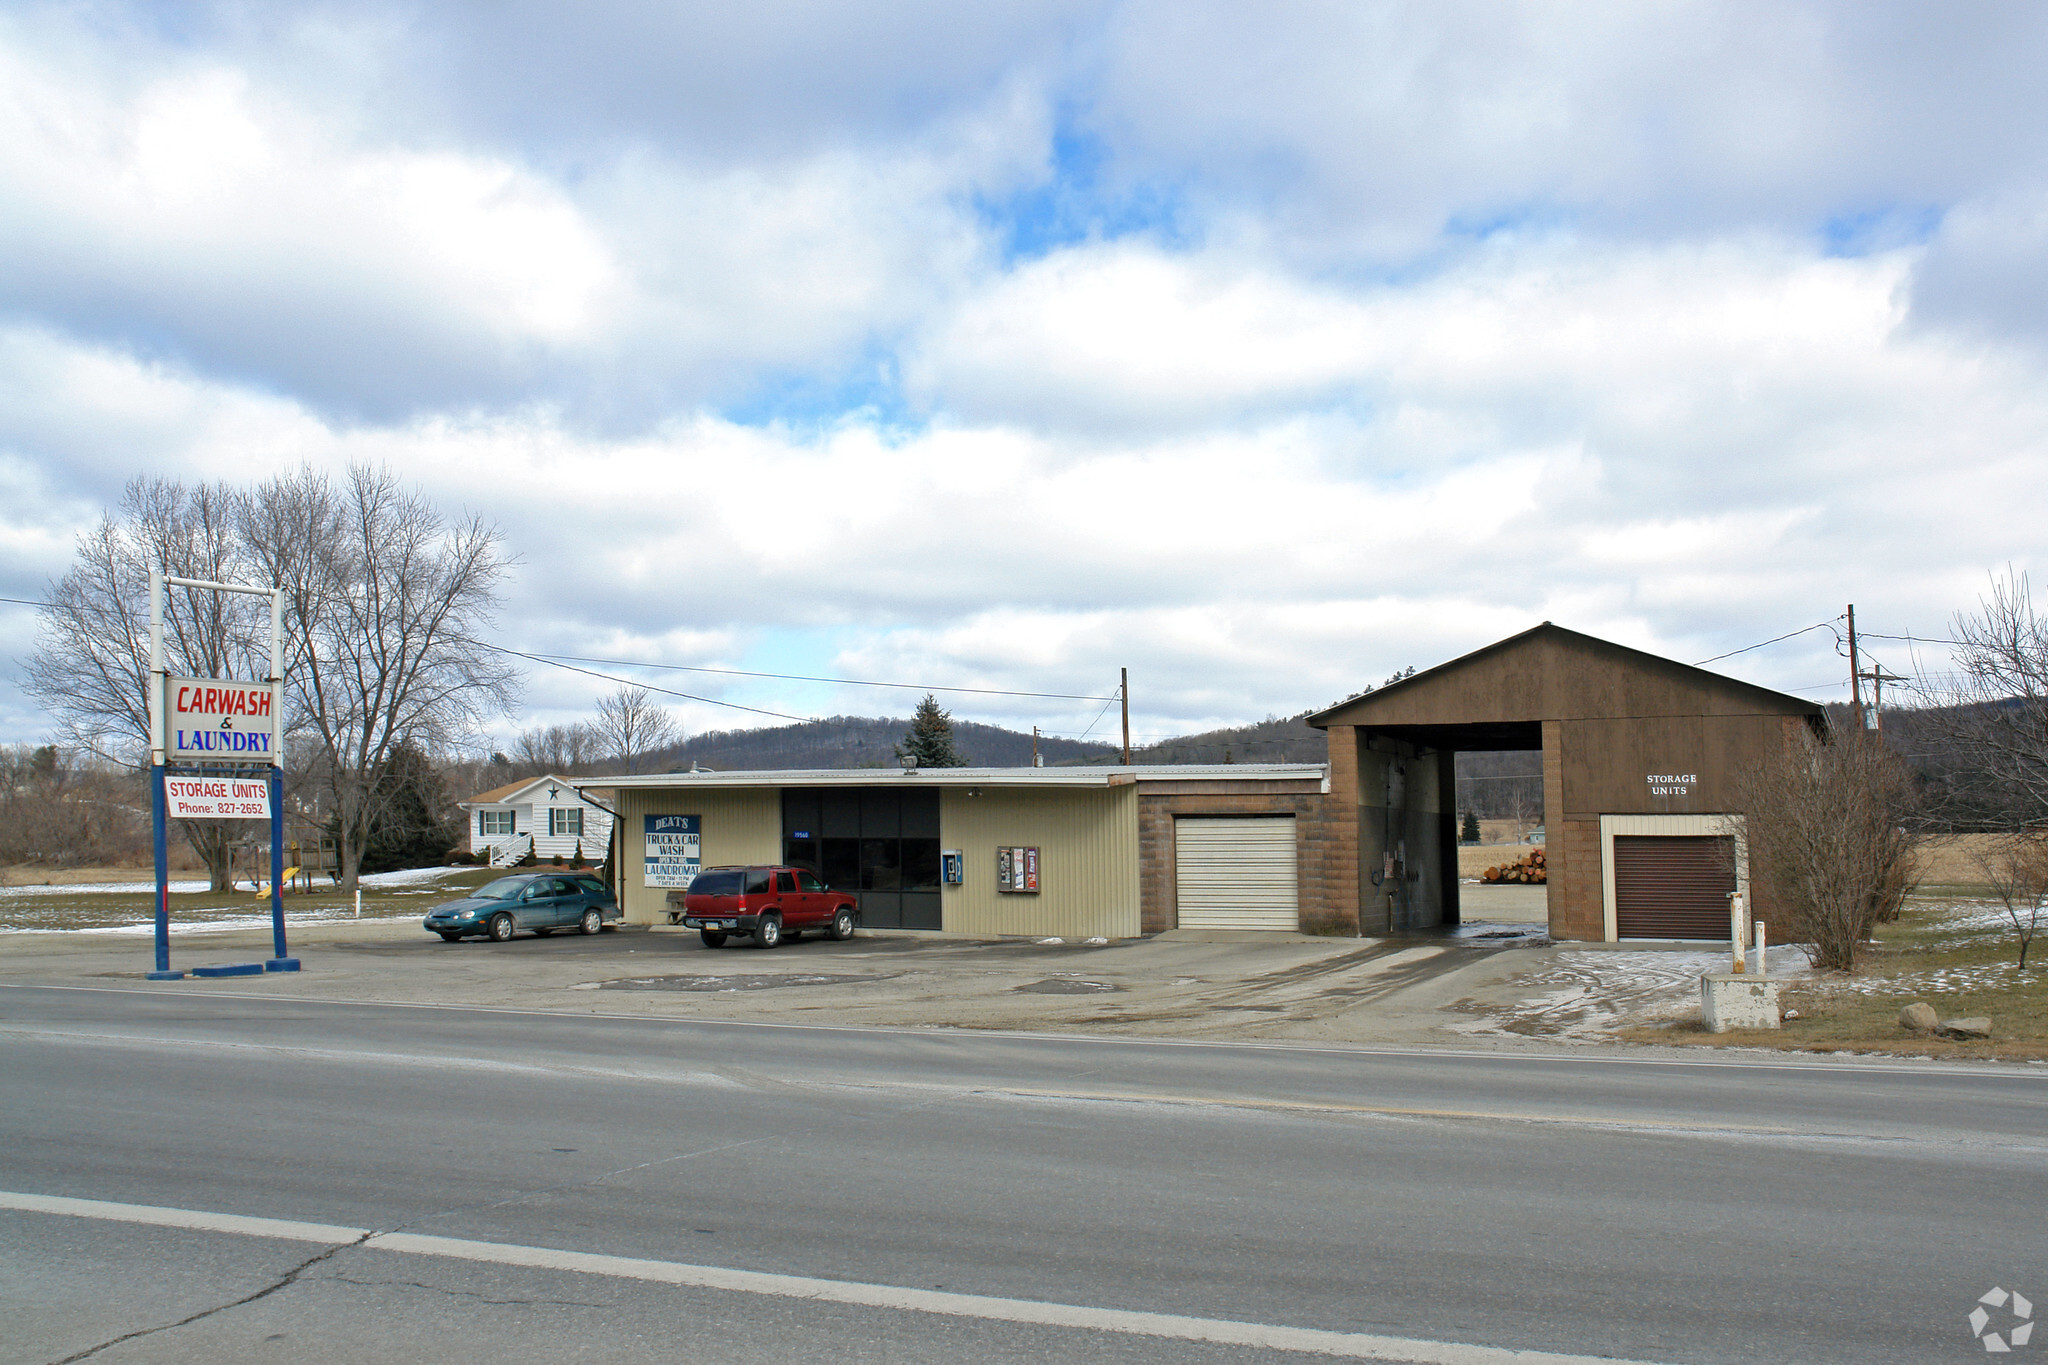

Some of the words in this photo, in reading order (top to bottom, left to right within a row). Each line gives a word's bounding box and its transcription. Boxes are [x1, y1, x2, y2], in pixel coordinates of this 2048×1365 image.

[177, 687, 272, 716] CARWASH
[220, 717, 233, 729] &
[177, 730, 272, 752] LAUNDRY
[1647, 774, 1697, 783] STORAGE
[170, 782, 228, 798] STORAGE
[232, 784, 267, 799] UNITS
[1652, 786, 1687, 795] UNITS
[178, 802, 214, 814] Phone:
[217, 803, 264, 815] 827-2652
[647, 834, 673, 845] TRUCK
[674, 835, 681, 844] &
[682, 835, 699, 845] CAR
[659, 845, 685, 856] WASH
[645, 864, 700, 876] LAUNDROMAT
